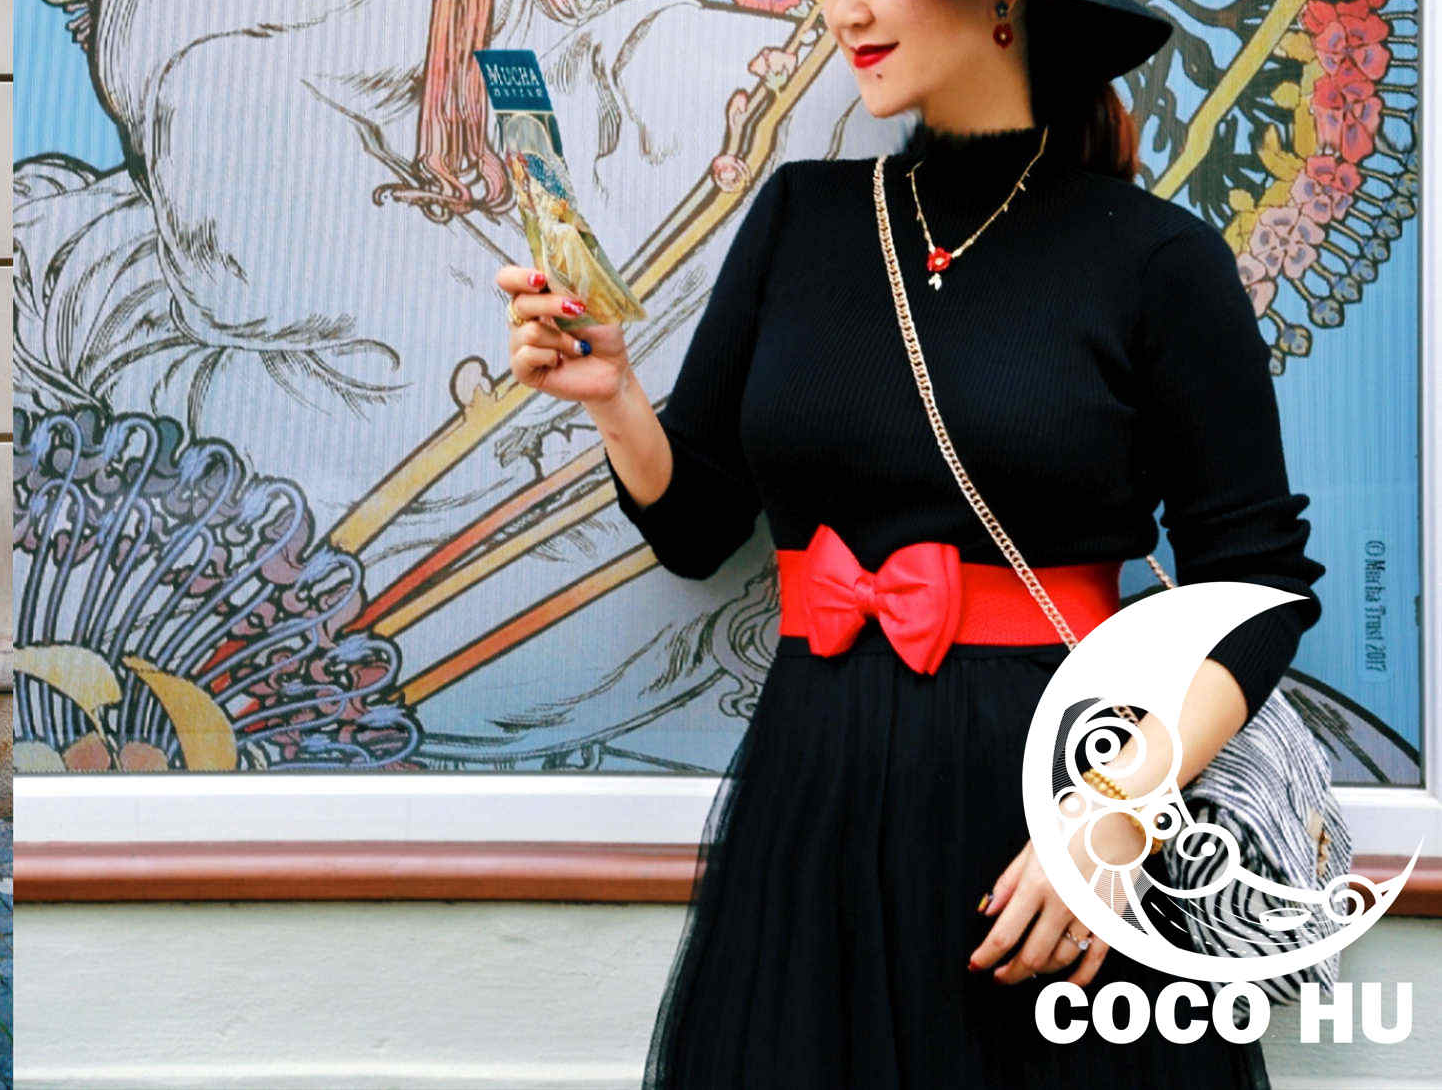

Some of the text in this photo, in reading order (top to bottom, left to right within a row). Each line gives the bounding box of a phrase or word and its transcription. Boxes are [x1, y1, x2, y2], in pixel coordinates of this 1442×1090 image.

[485, 63, 540, 87] MUCHA
[1365, 606, 1387, 641] Trust
[1365, 643, 1387, 673] 2017
